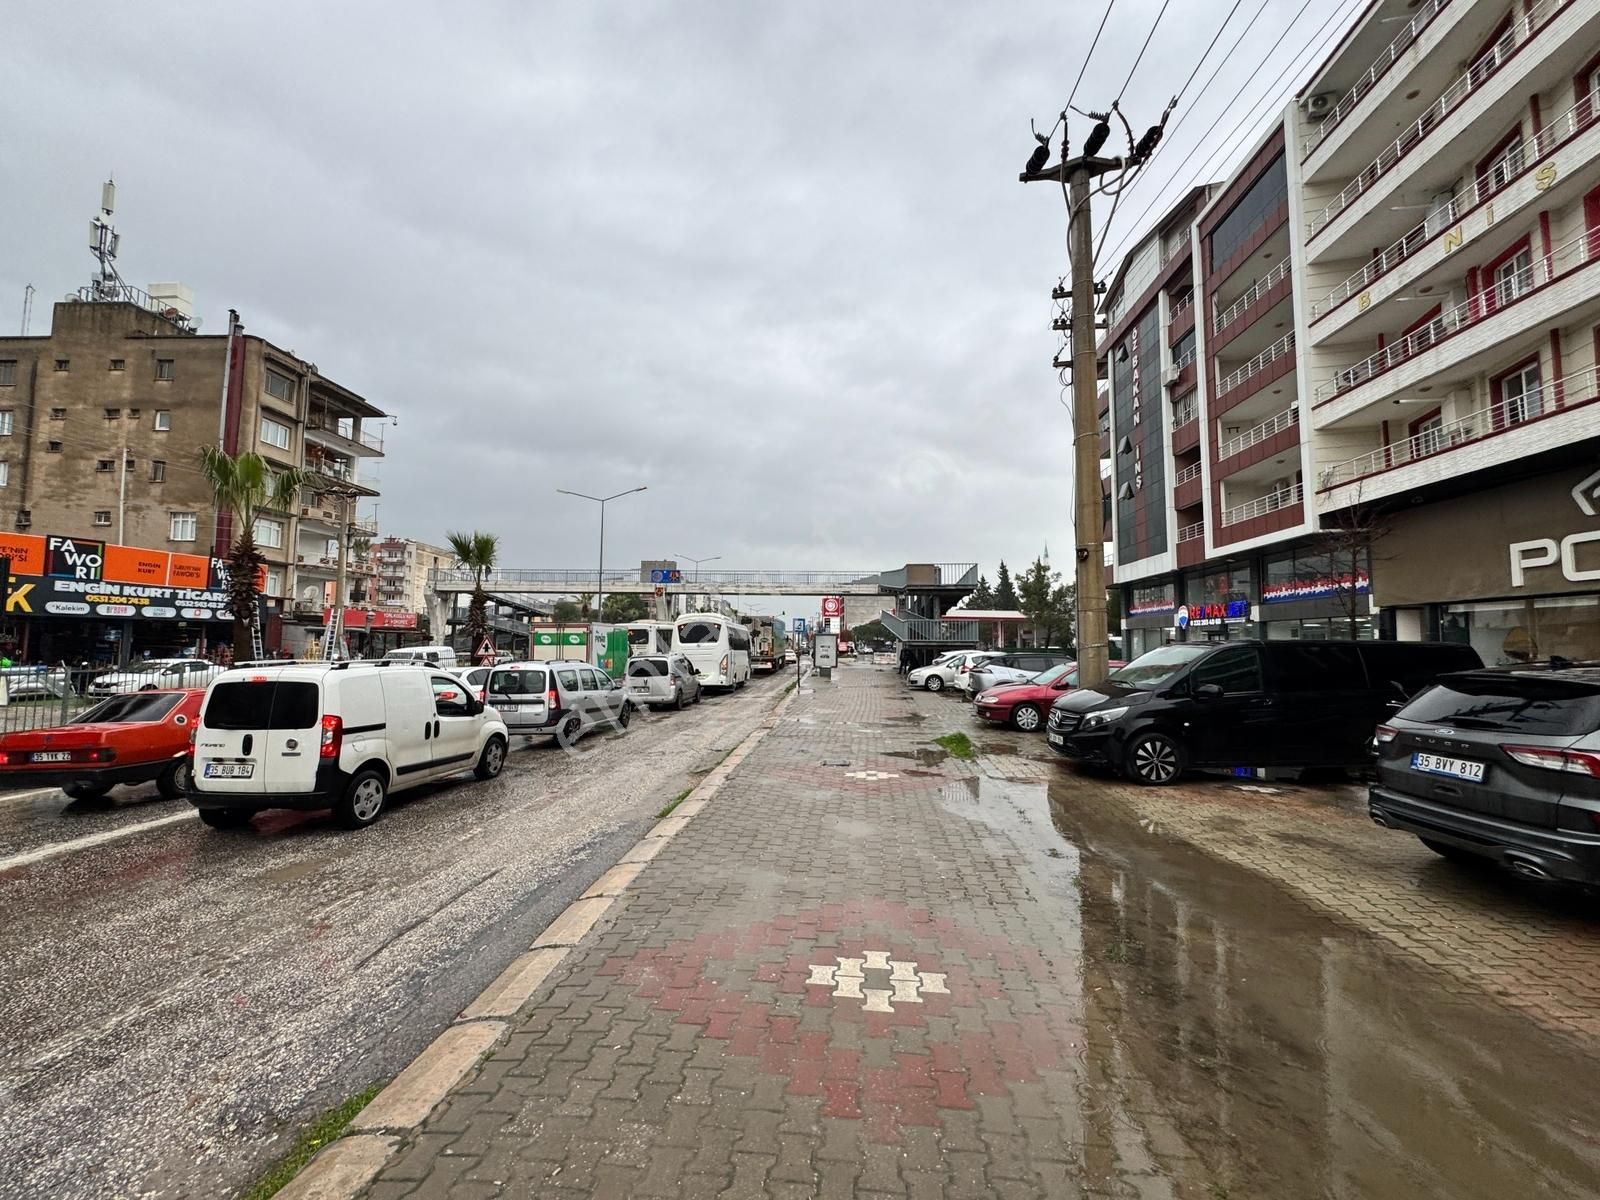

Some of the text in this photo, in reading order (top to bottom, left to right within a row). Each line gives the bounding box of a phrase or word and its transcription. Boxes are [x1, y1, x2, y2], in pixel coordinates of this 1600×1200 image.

[1131, 355, 1140, 427] BAKAN
[49, 537, 76, 552] FA
[64, 552, 102, 567] WO
[123, 586, 174, 598] KURT
[209, 765, 219, 775] 35
[1418, 754, 1482, 777] 35 BVY 812
